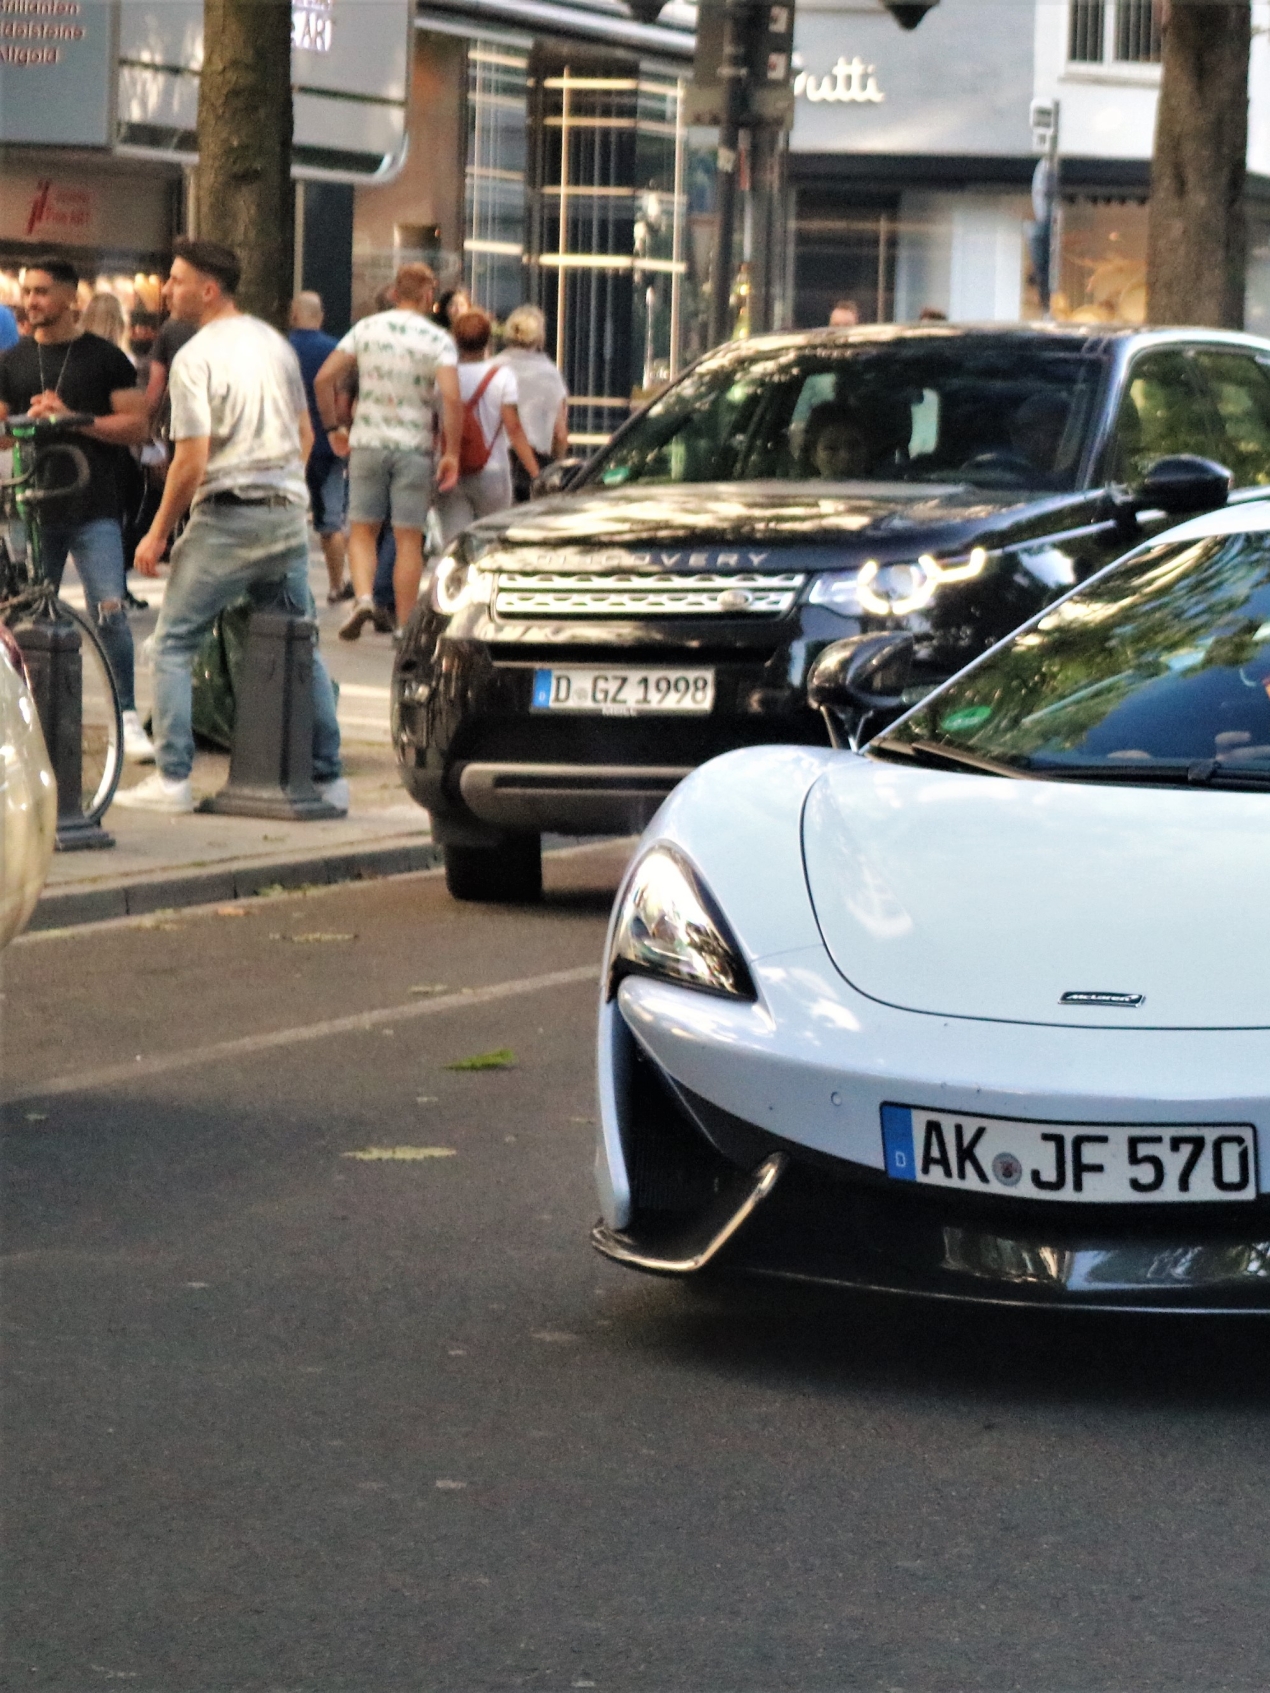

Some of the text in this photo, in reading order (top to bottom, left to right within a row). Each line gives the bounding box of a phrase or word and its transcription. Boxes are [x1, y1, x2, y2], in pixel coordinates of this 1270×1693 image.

[553, 674, 708, 705] D GZ 1998
[920, 1119, 1249, 1193] AK JF 570
